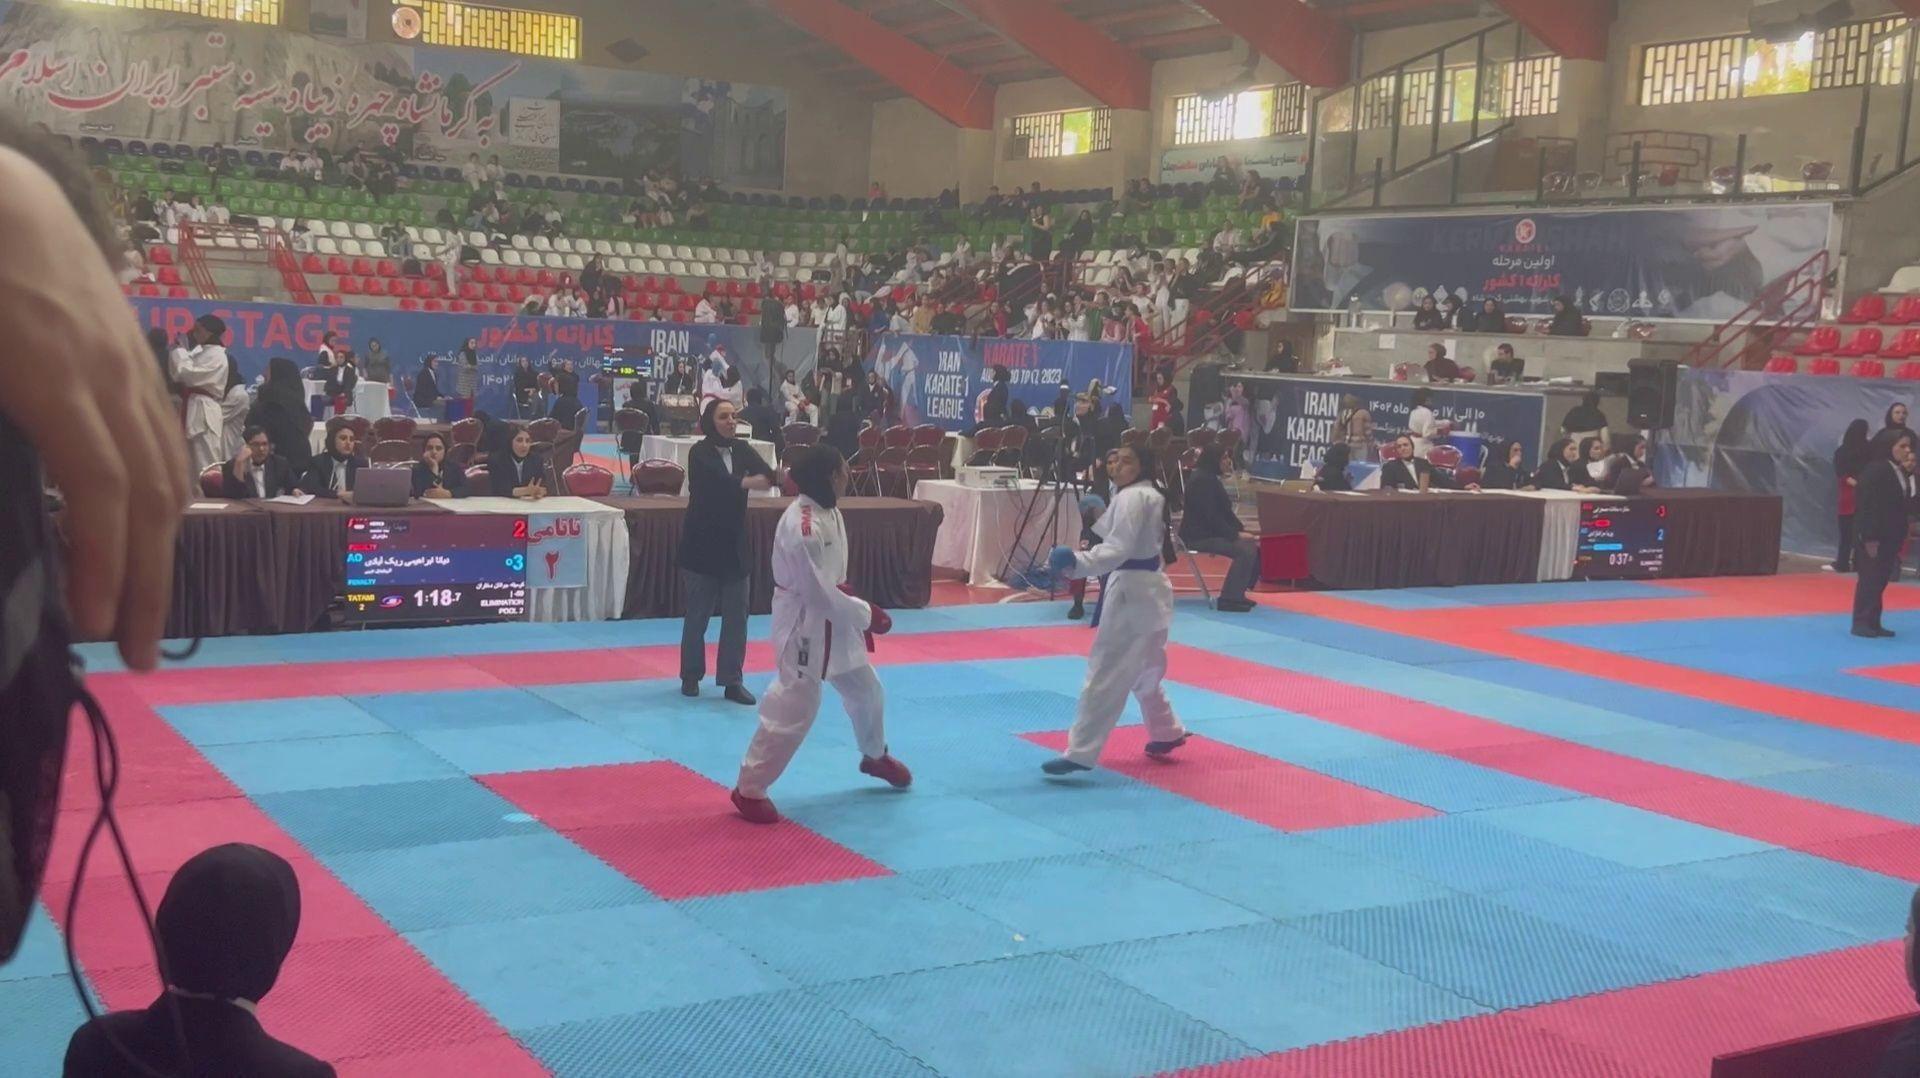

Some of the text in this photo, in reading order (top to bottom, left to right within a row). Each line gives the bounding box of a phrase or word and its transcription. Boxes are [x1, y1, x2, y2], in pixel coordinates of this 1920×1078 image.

[48, 56, 181, 111] ایران
[397, 59, 521, 139] کرمانشاه
[347, 91, 399, 147] چهره
[1492, 254, 1556, 270] اولین مرحله
[555, 323, 616, 352] کاراته
[938, 351, 961, 372] IRAN
[983, 342, 1028, 369] KARATE
[924, 373, 962, 396] KARATE
[1042, 368, 1062, 385] 2023
[926, 396, 965, 420] LEAGUE
[1304, 391, 1340, 417] IRAN
[1286, 416, 1333, 444] KARAT
[513, 519, 526, 538] 2
[526, 517, 581, 546] تاتامی
[1657, 528, 1664, 541] 2
